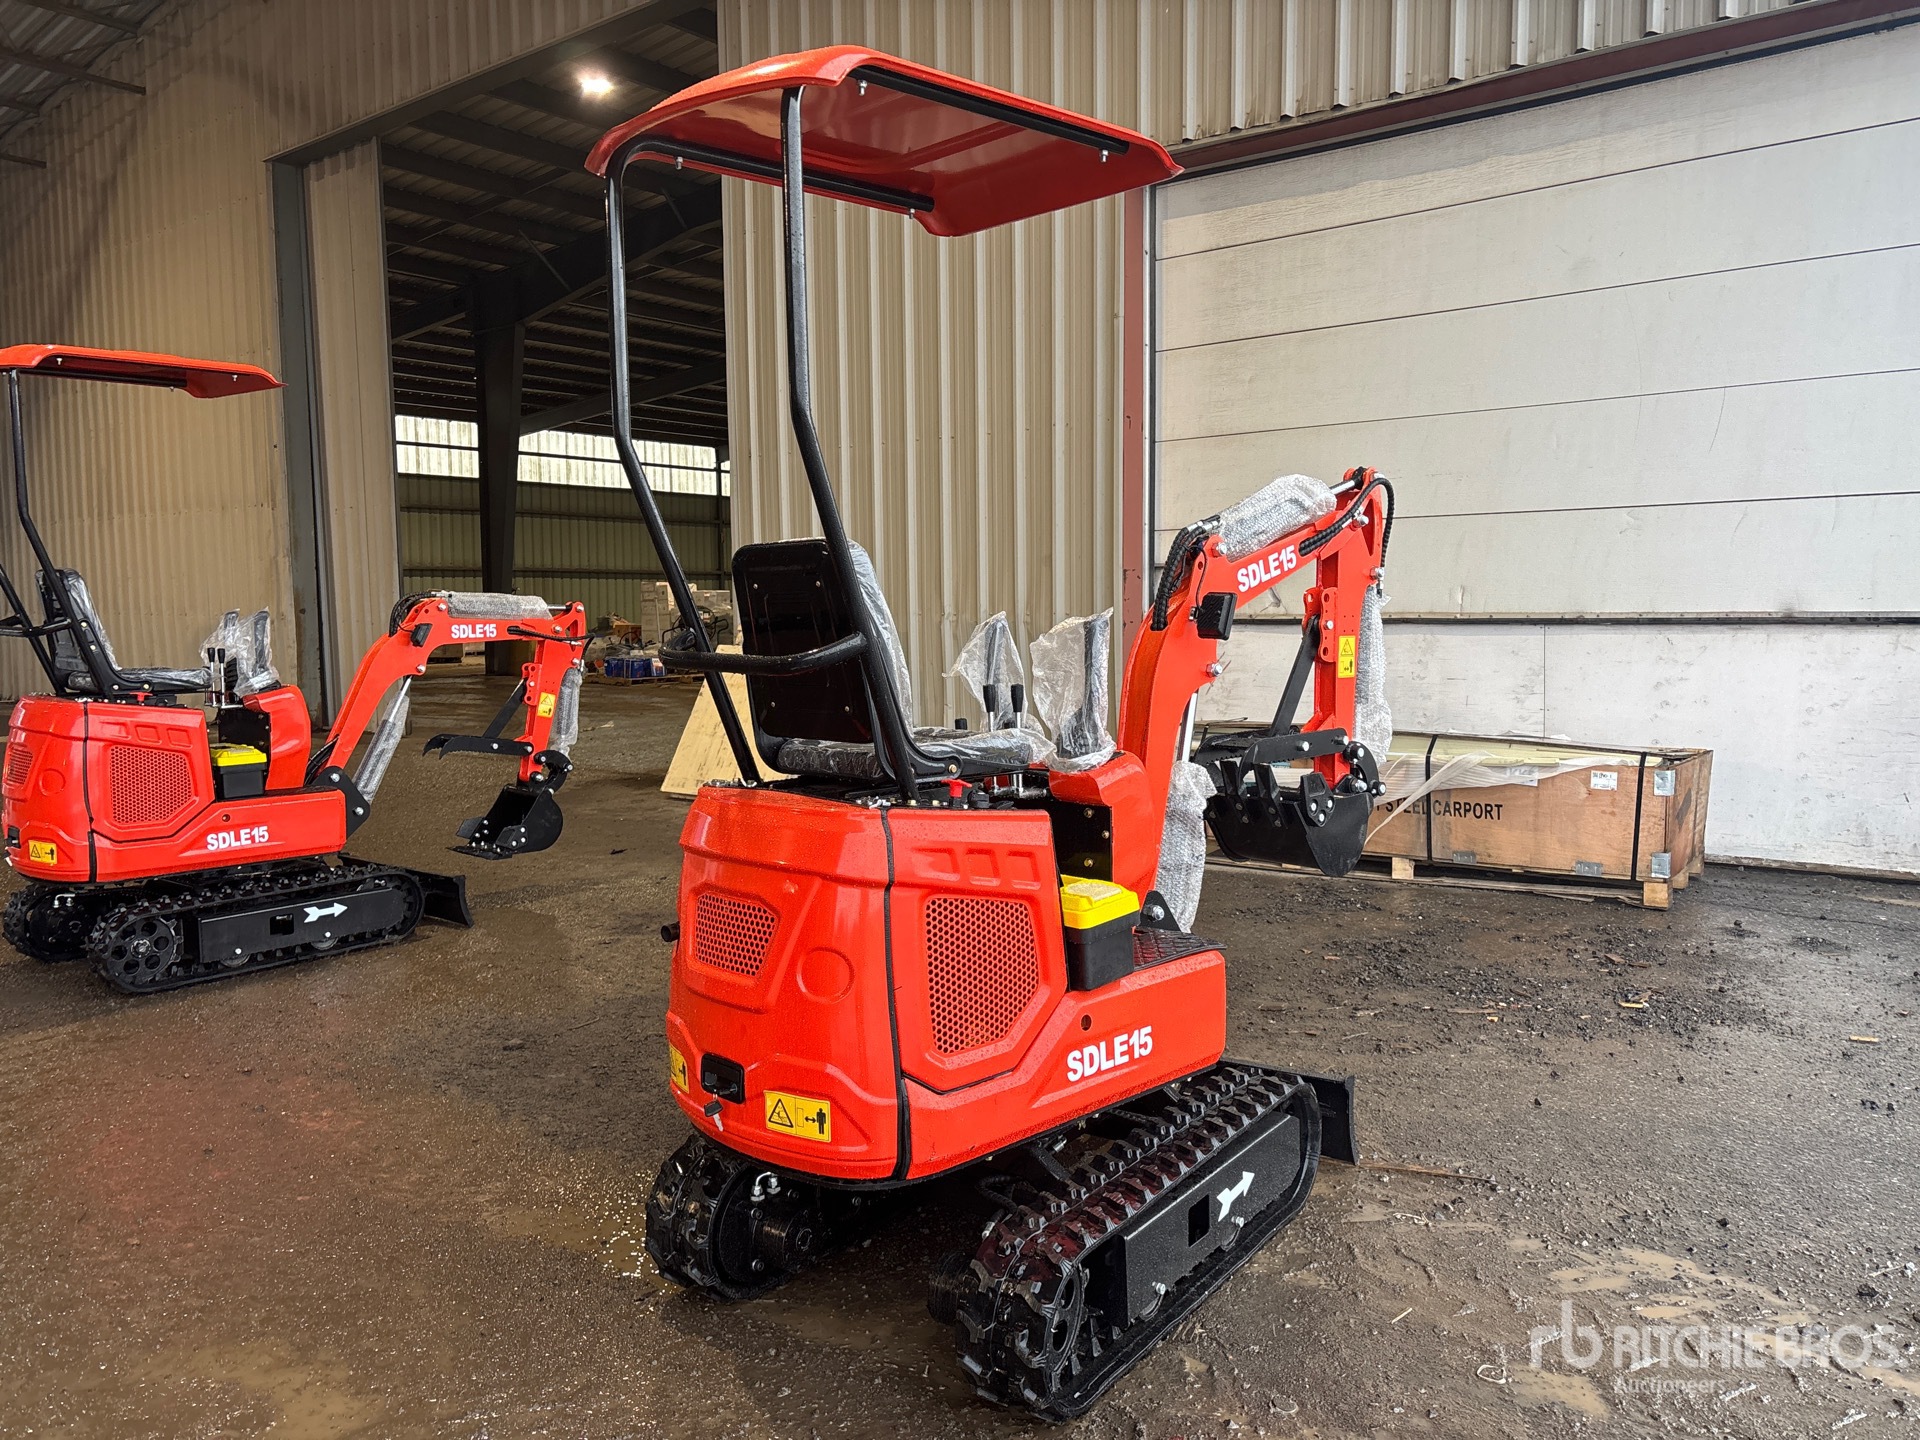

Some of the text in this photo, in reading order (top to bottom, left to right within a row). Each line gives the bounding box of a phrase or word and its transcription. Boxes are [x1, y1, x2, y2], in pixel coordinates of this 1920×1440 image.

[1237, 544, 1297, 593] SDLE15
[451, 623, 497, 639] SDLE15
[1432, 800, 1503, 820] CARPORT
[206, 825, 269, 851] SDLE15
[1066, 1025, 1153, 1083] SDLE15
